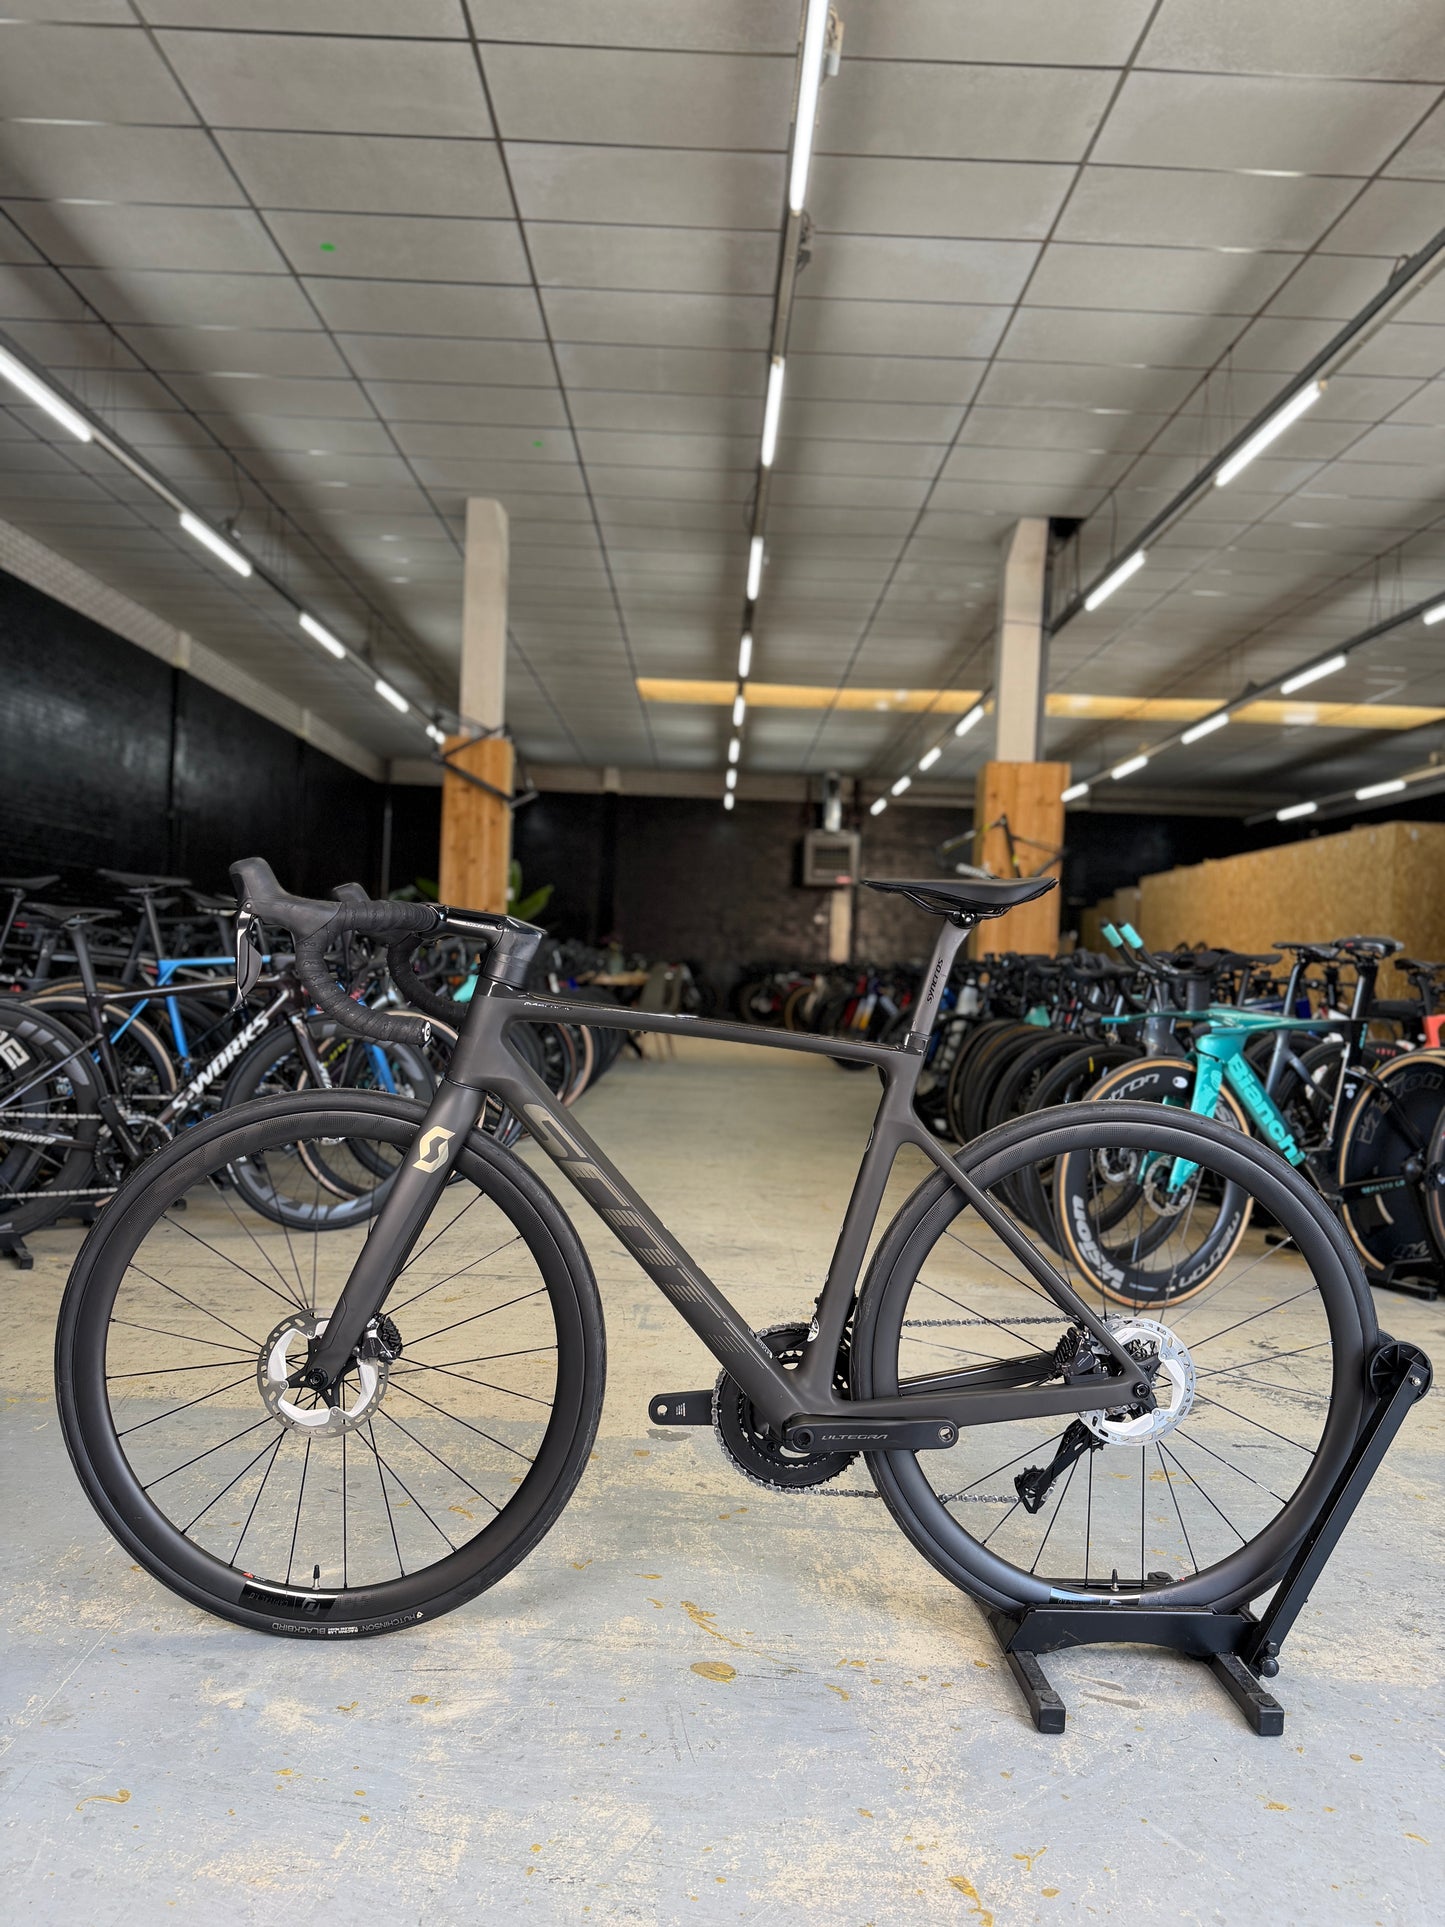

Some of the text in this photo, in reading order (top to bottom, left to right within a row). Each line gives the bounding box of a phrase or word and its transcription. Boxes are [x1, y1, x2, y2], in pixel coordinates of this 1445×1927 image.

[171, 1010, 269, 1117] S-WORKS
[1106, 1072, 1160, 1101] tron
[1228, 1052, 1307, 1167] Bianchi
[522, 1103, 765, 1369] SCOTT
[821, 1433, 889, 1441] ULTEGRA
[271, 1622, 326, 1635] BLACKBIRD
[362, 1614, 416, 1631] HUTCHINSON
